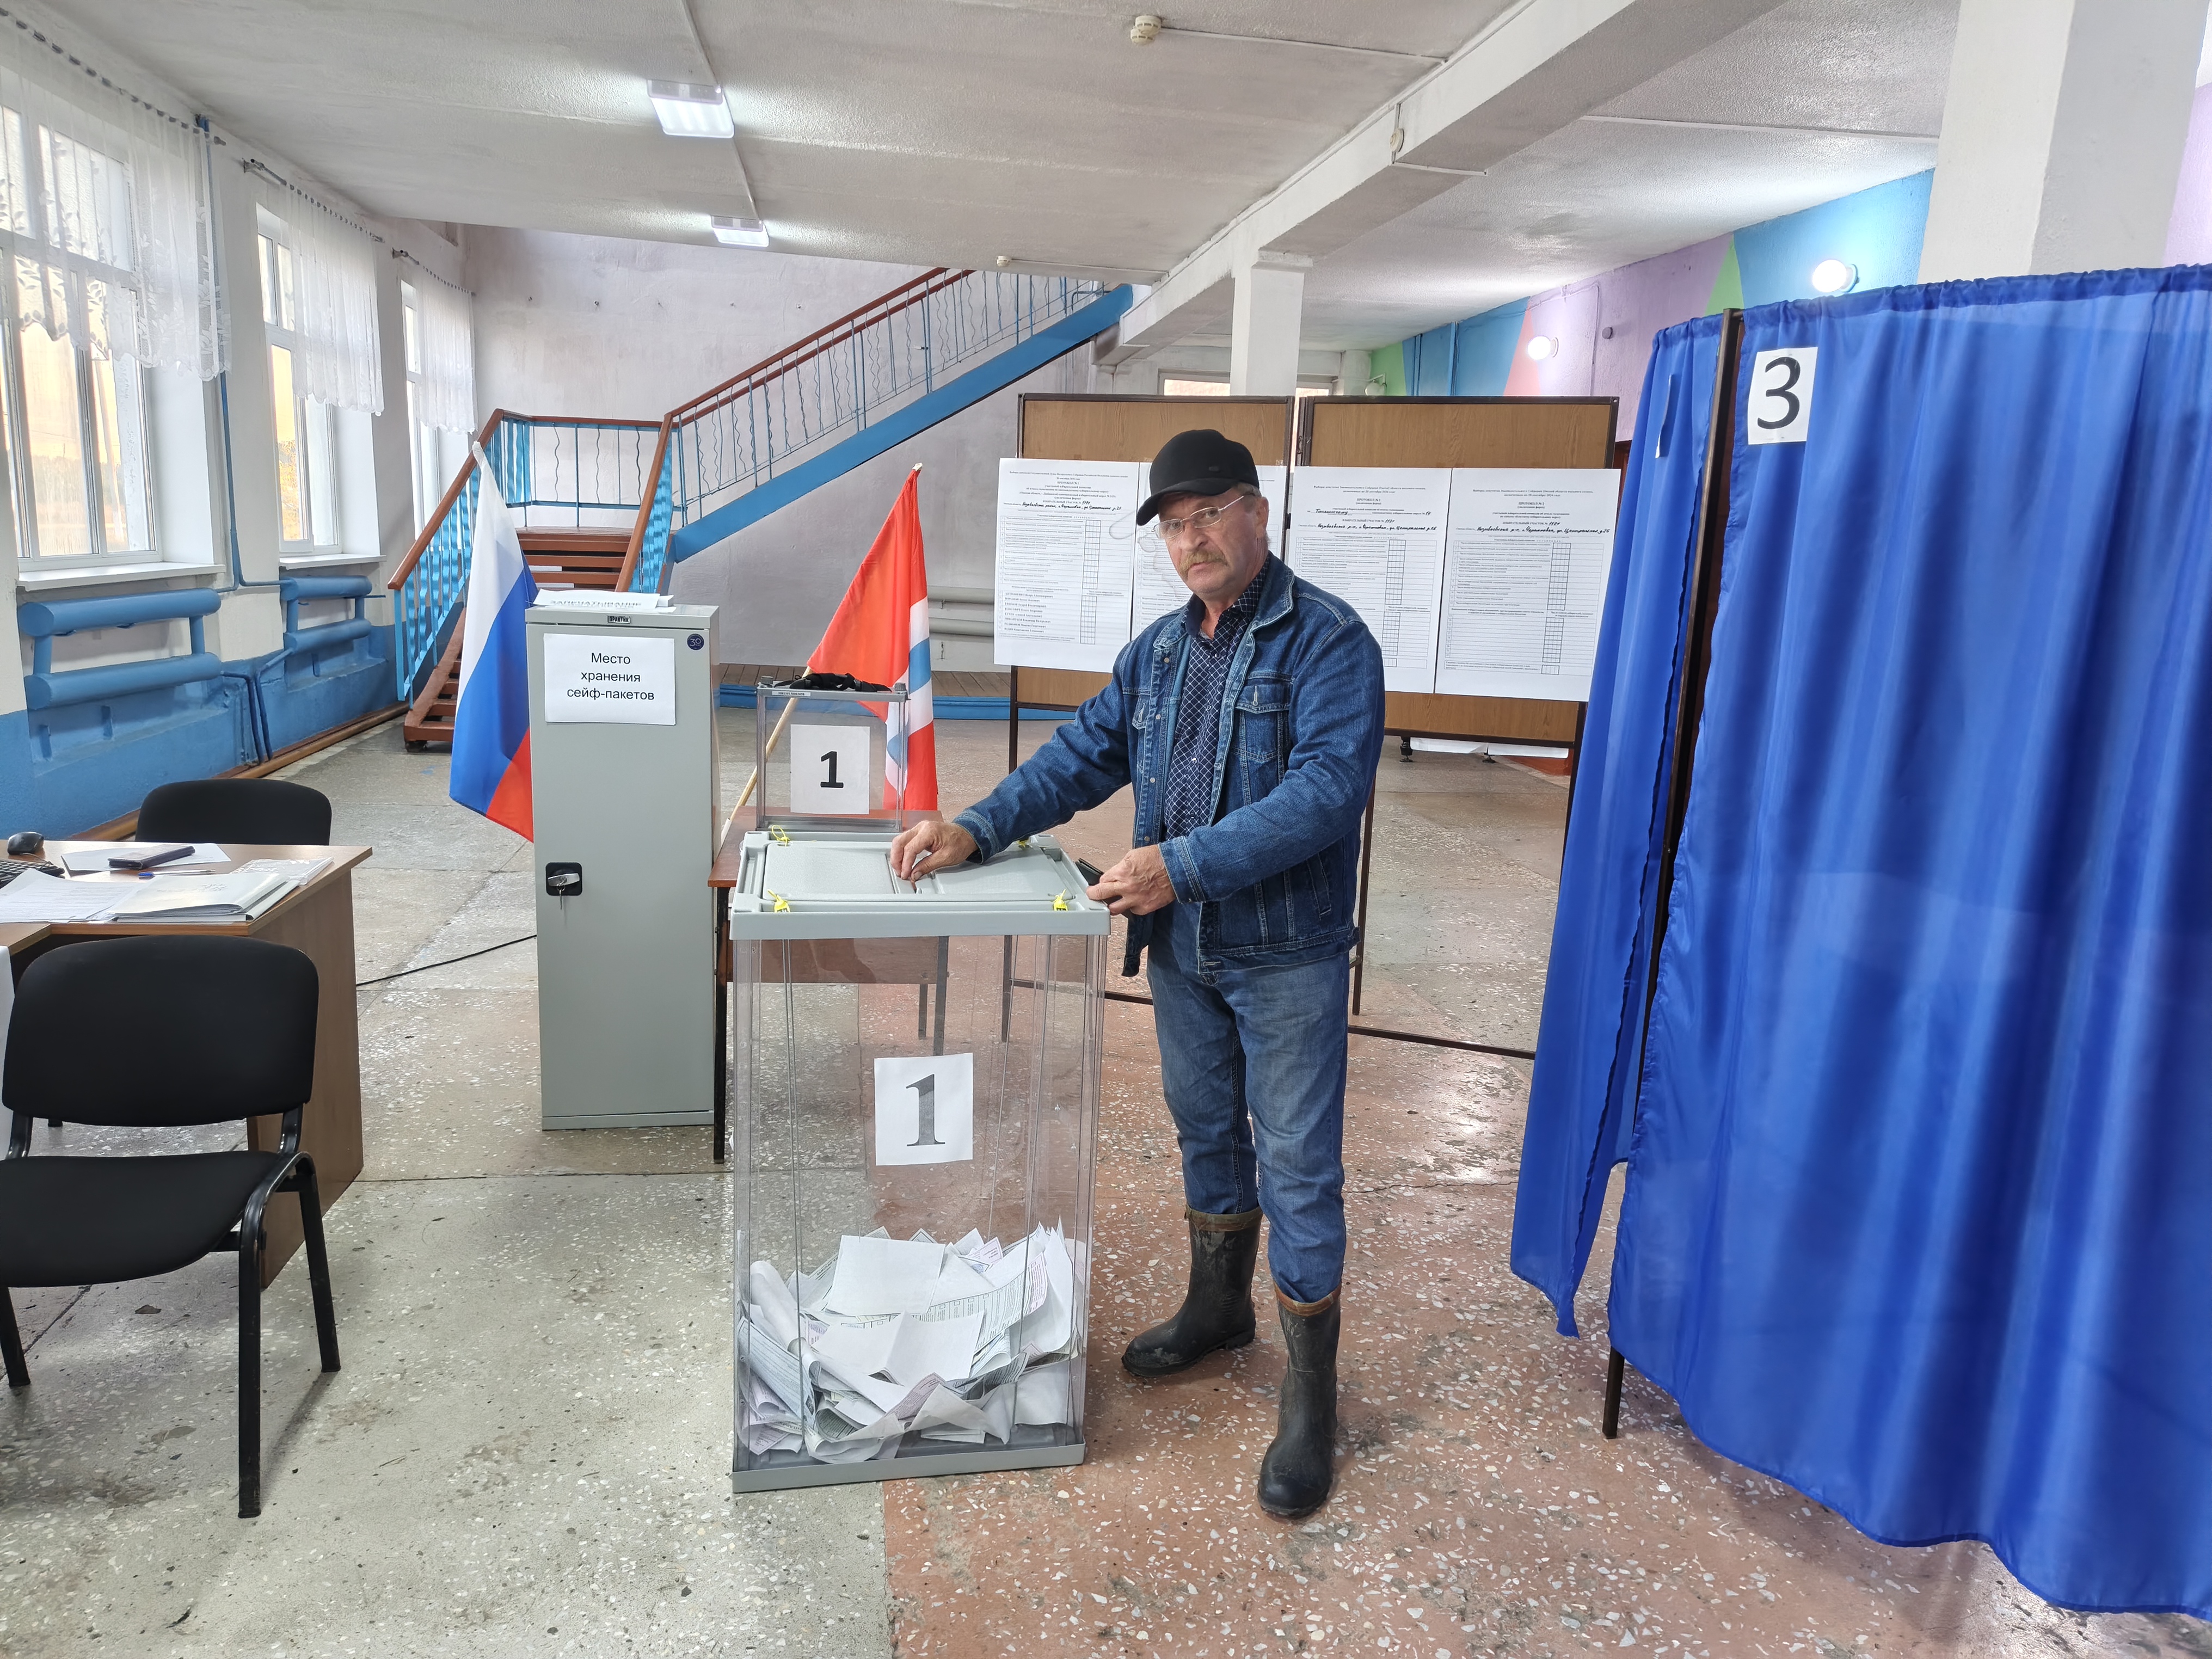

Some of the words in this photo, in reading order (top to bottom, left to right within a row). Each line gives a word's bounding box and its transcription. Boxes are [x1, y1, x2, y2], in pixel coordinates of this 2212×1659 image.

[1757, 357, 1801, 429] 3
[690, 638, 702, 647] 30
[591, 653, 631, 665] Место
[581, 671, 641, 683] хранения
[567, 687, 654, 701] сейф-пакетов
[820, 751, 844, 789] 1
[906, 1073, 945, 1147] 1
